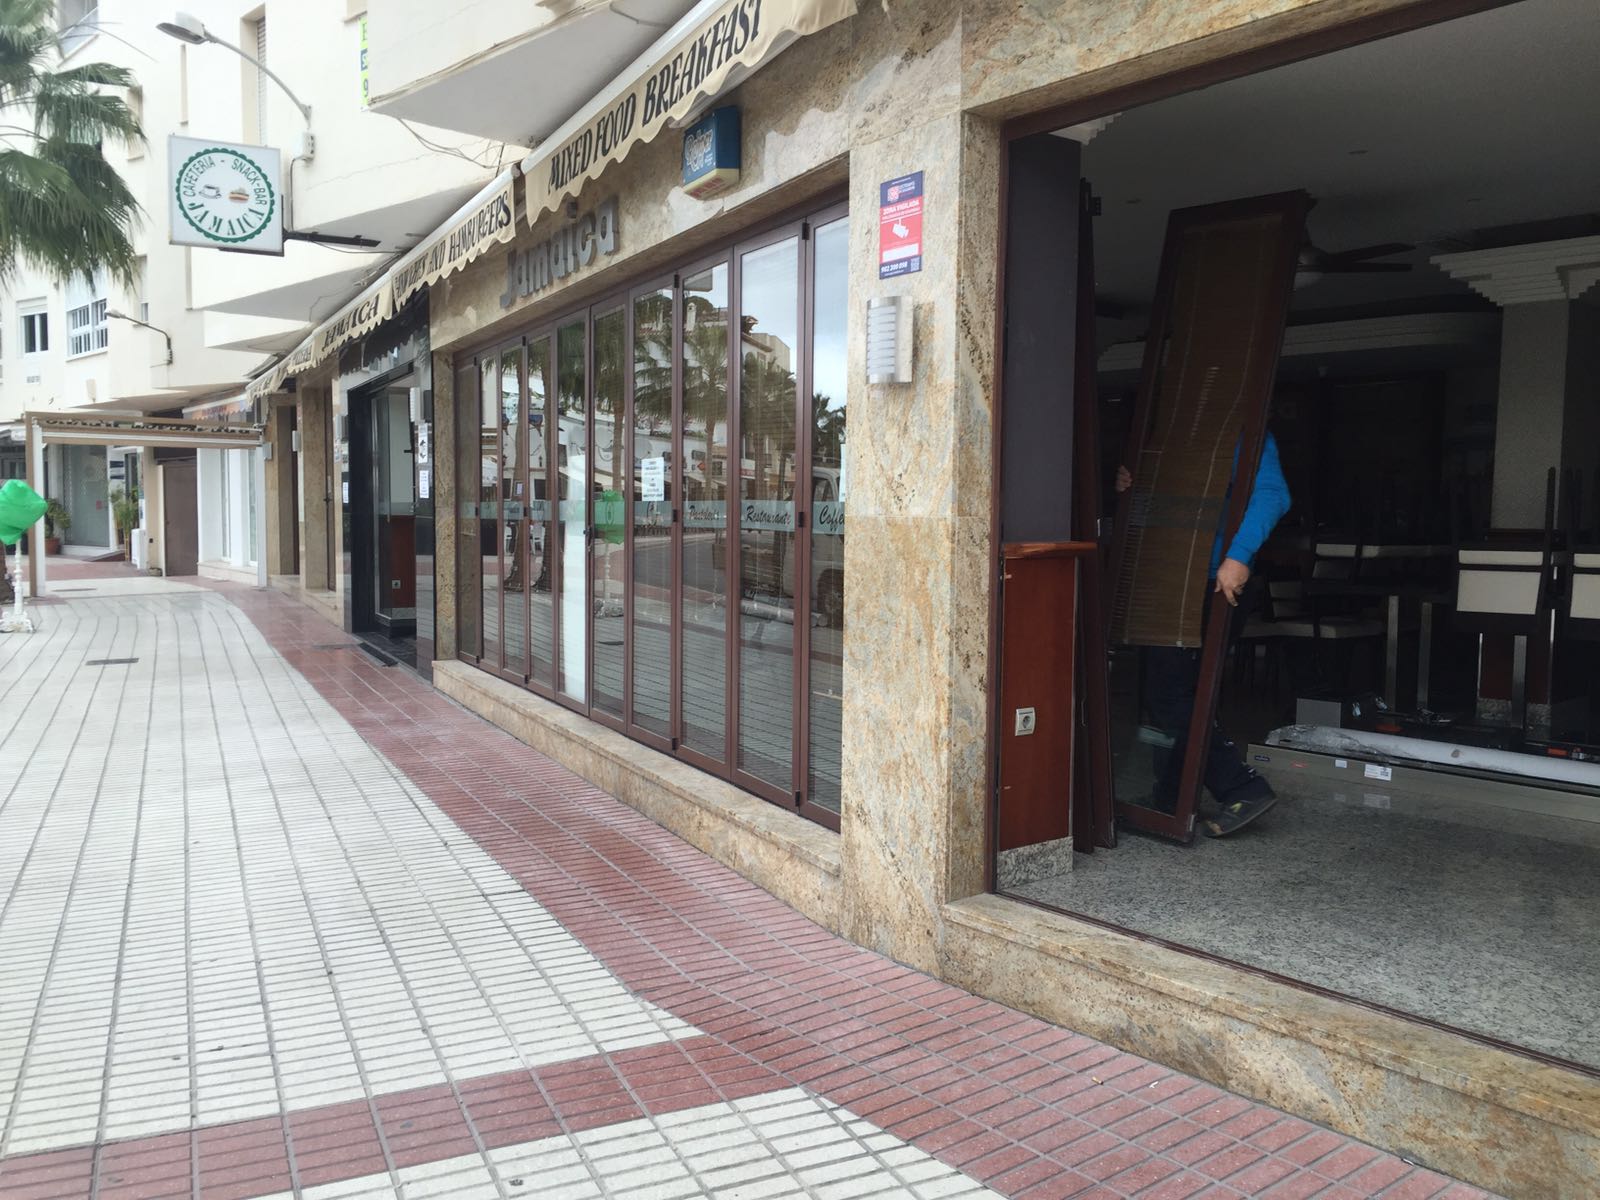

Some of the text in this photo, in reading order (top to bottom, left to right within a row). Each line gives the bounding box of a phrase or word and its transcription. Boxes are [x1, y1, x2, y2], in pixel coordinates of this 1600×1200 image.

[548, 128, 593, 195] MIXED
[593, 92, 637, 164] FOOD
[642, 0, 762, 128] BREAKFAST
[183, 156, 216, 198] CAFETERIA
[231, 158, 268, 206] SNACK-BAR
[188, 202, 265, 236] JAMAICA
[449, 191, 512, 263] HAMBURGERS
[500, 199, 618, 309] Jamaica
